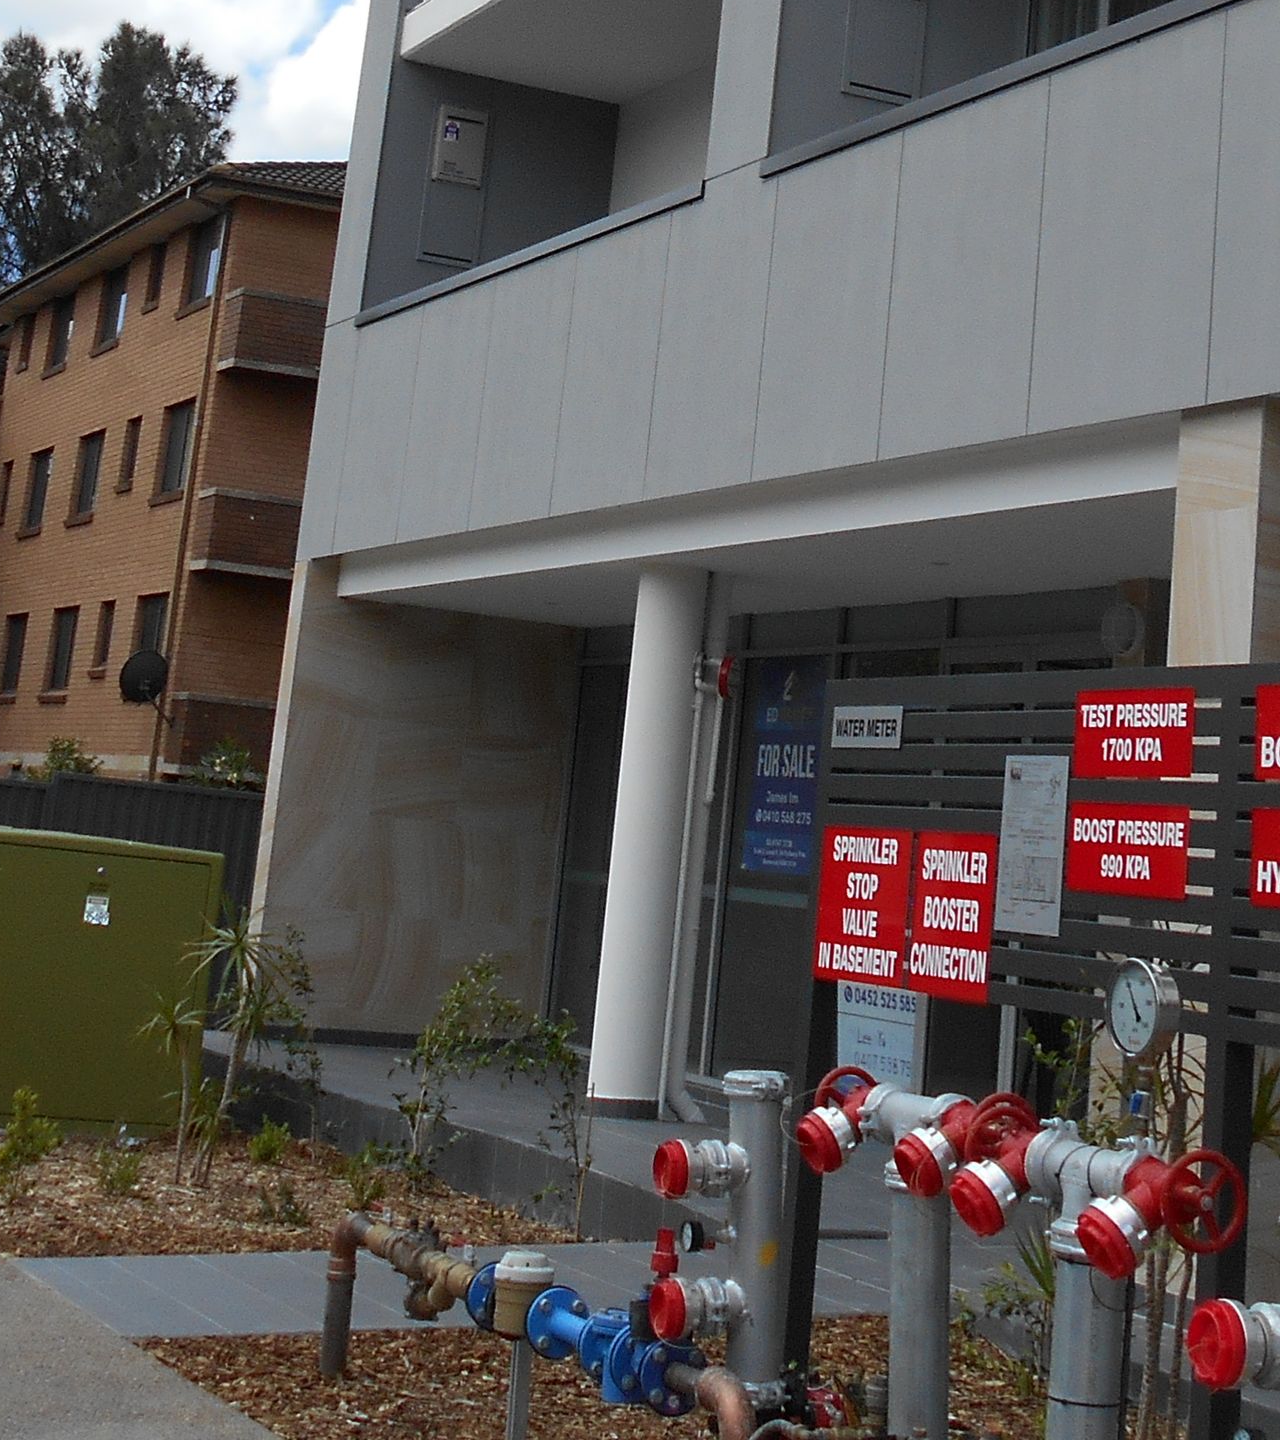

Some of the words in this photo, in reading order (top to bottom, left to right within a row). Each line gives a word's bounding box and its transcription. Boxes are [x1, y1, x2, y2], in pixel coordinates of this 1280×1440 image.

[835, 718, 865, 737] WATER
[866, 718, 898, 737] METER
[1081, 704, 1114, 728] TEST
[1116, 703, 1187, 728] PRESSURE
[756, 743, 780, 777] FOR
[782, 744, 816, 779] SALE
[1101, 737, 1133, 761] 1700
[1134, 737, 1162, 761] KPA
[1073, 818, 1115, 844] BOOST
[1117, 820, 1185, 847] PRESSURE
[833, 835, 898, 865] SPRINKLER
[922, 848, 988, 885] SPRINKLER
[1100, 854, 1123, 878] 990
[1125, 855, 1151, 880] KPA
[846, 872, 879, 900] STOP
[842, 907, 878, 938] VALVE
[923, 895, 980, 933] BOOSTER
[818, 942, 831, 969] IN
[832, 943, 898, 978] BASEMENT
[909, 942, 987, 984] CONNECTION
[854, 987, 878, 1007] 0452
[880, 991, 898, 1010] 525
